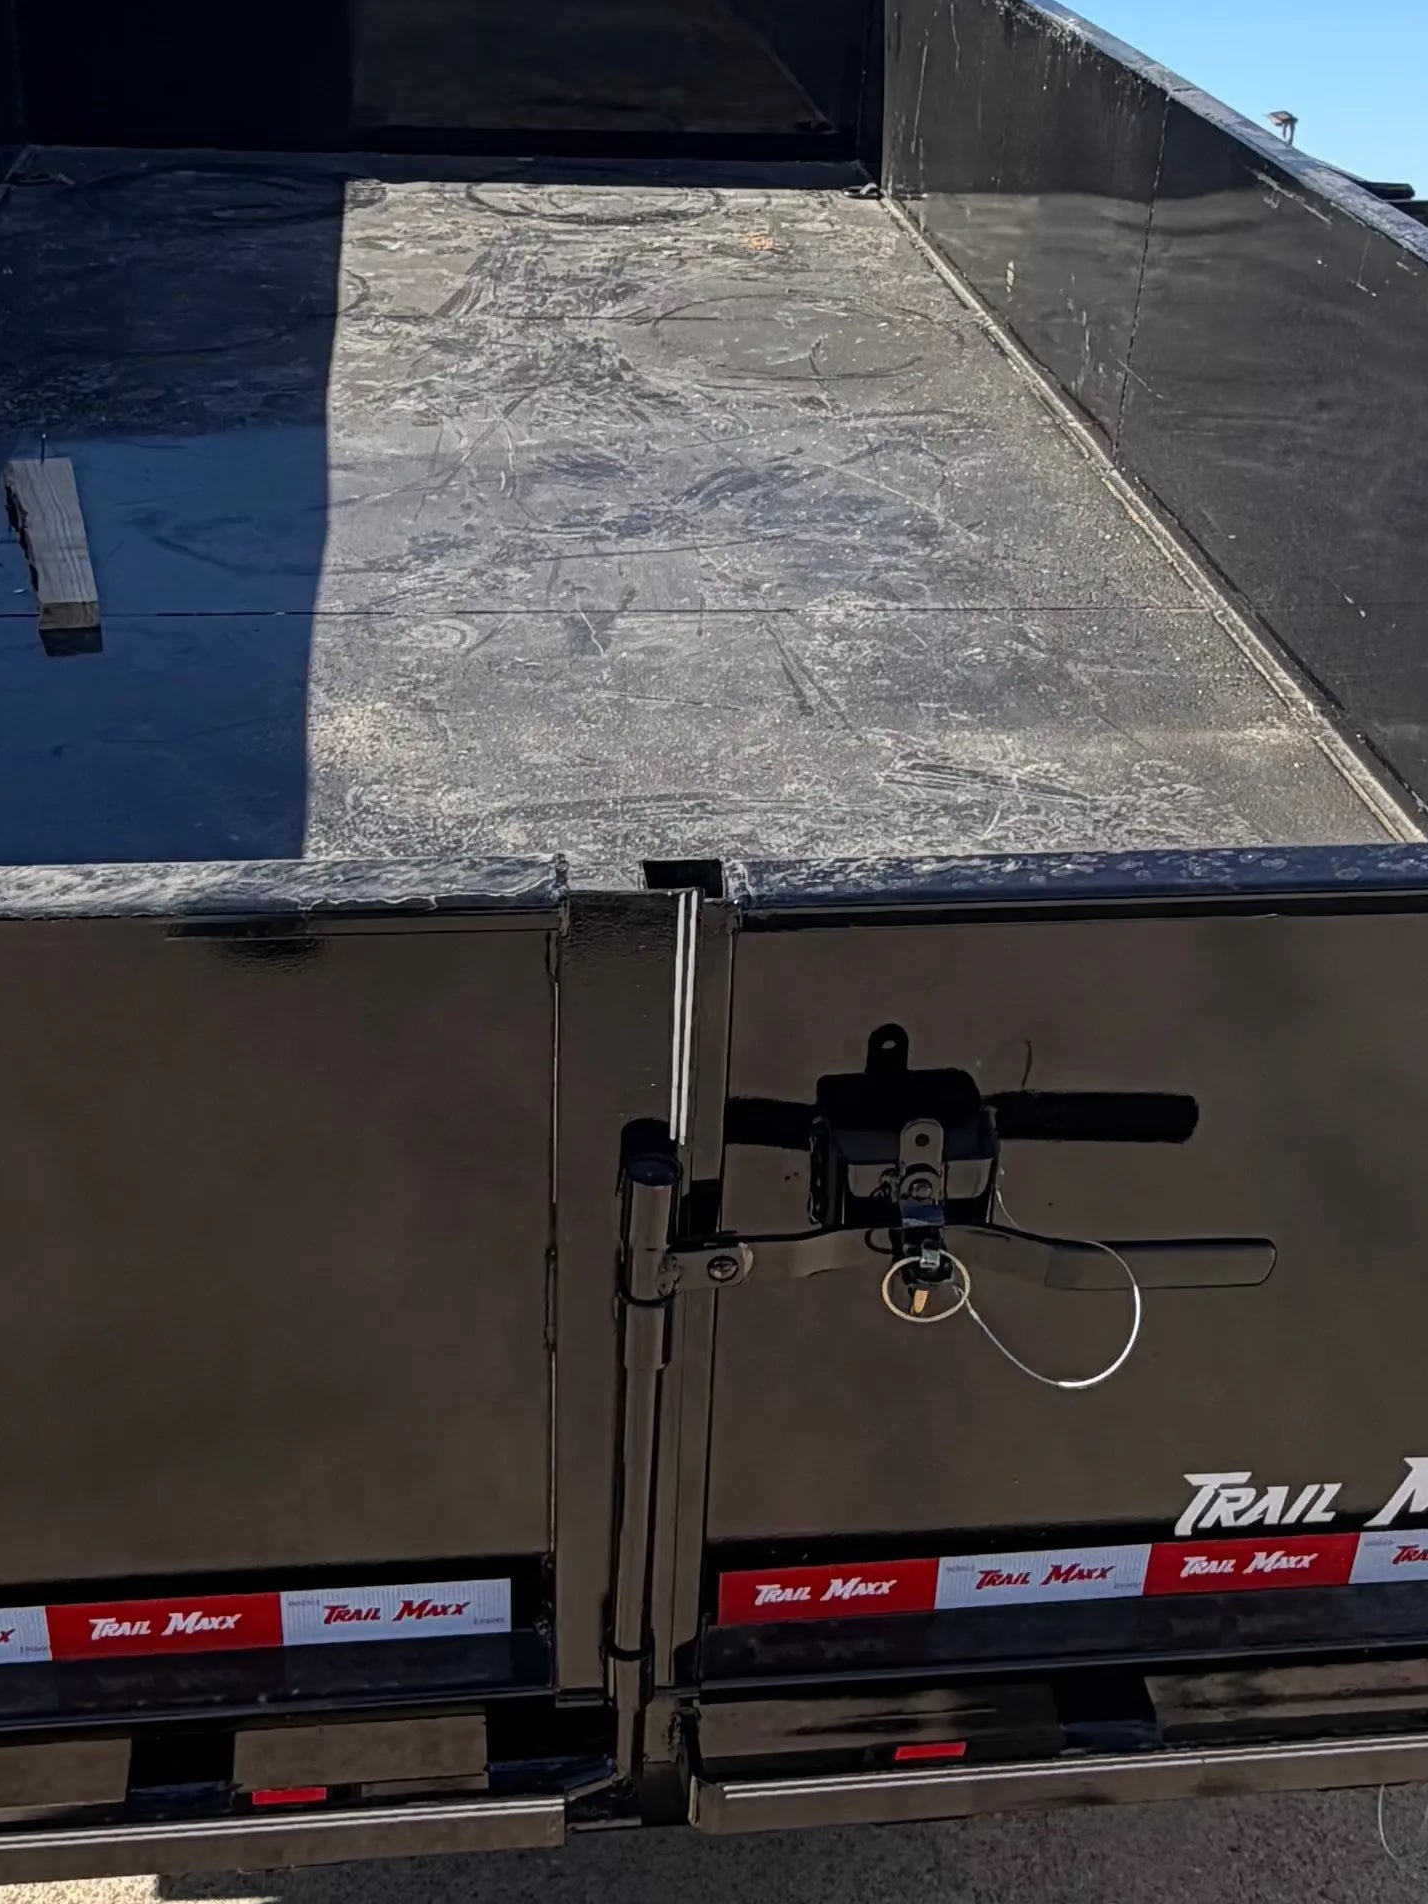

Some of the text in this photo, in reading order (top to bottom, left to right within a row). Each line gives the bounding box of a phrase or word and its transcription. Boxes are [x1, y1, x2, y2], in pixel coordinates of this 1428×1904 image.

[1174, 1470, 1344, 1536] TRAIL
[975, 1564, 1115, 1589] TRAIL MAXX
[1180, 1551, 1319, 1577] TRAIL MAXX
[755, 1577, 898, 1606] TRAIL MAXX
[89, 1611, 242, 1640] TRAIL MAXX
[323, 1599, 469, 1626] TRAIL MAXX
